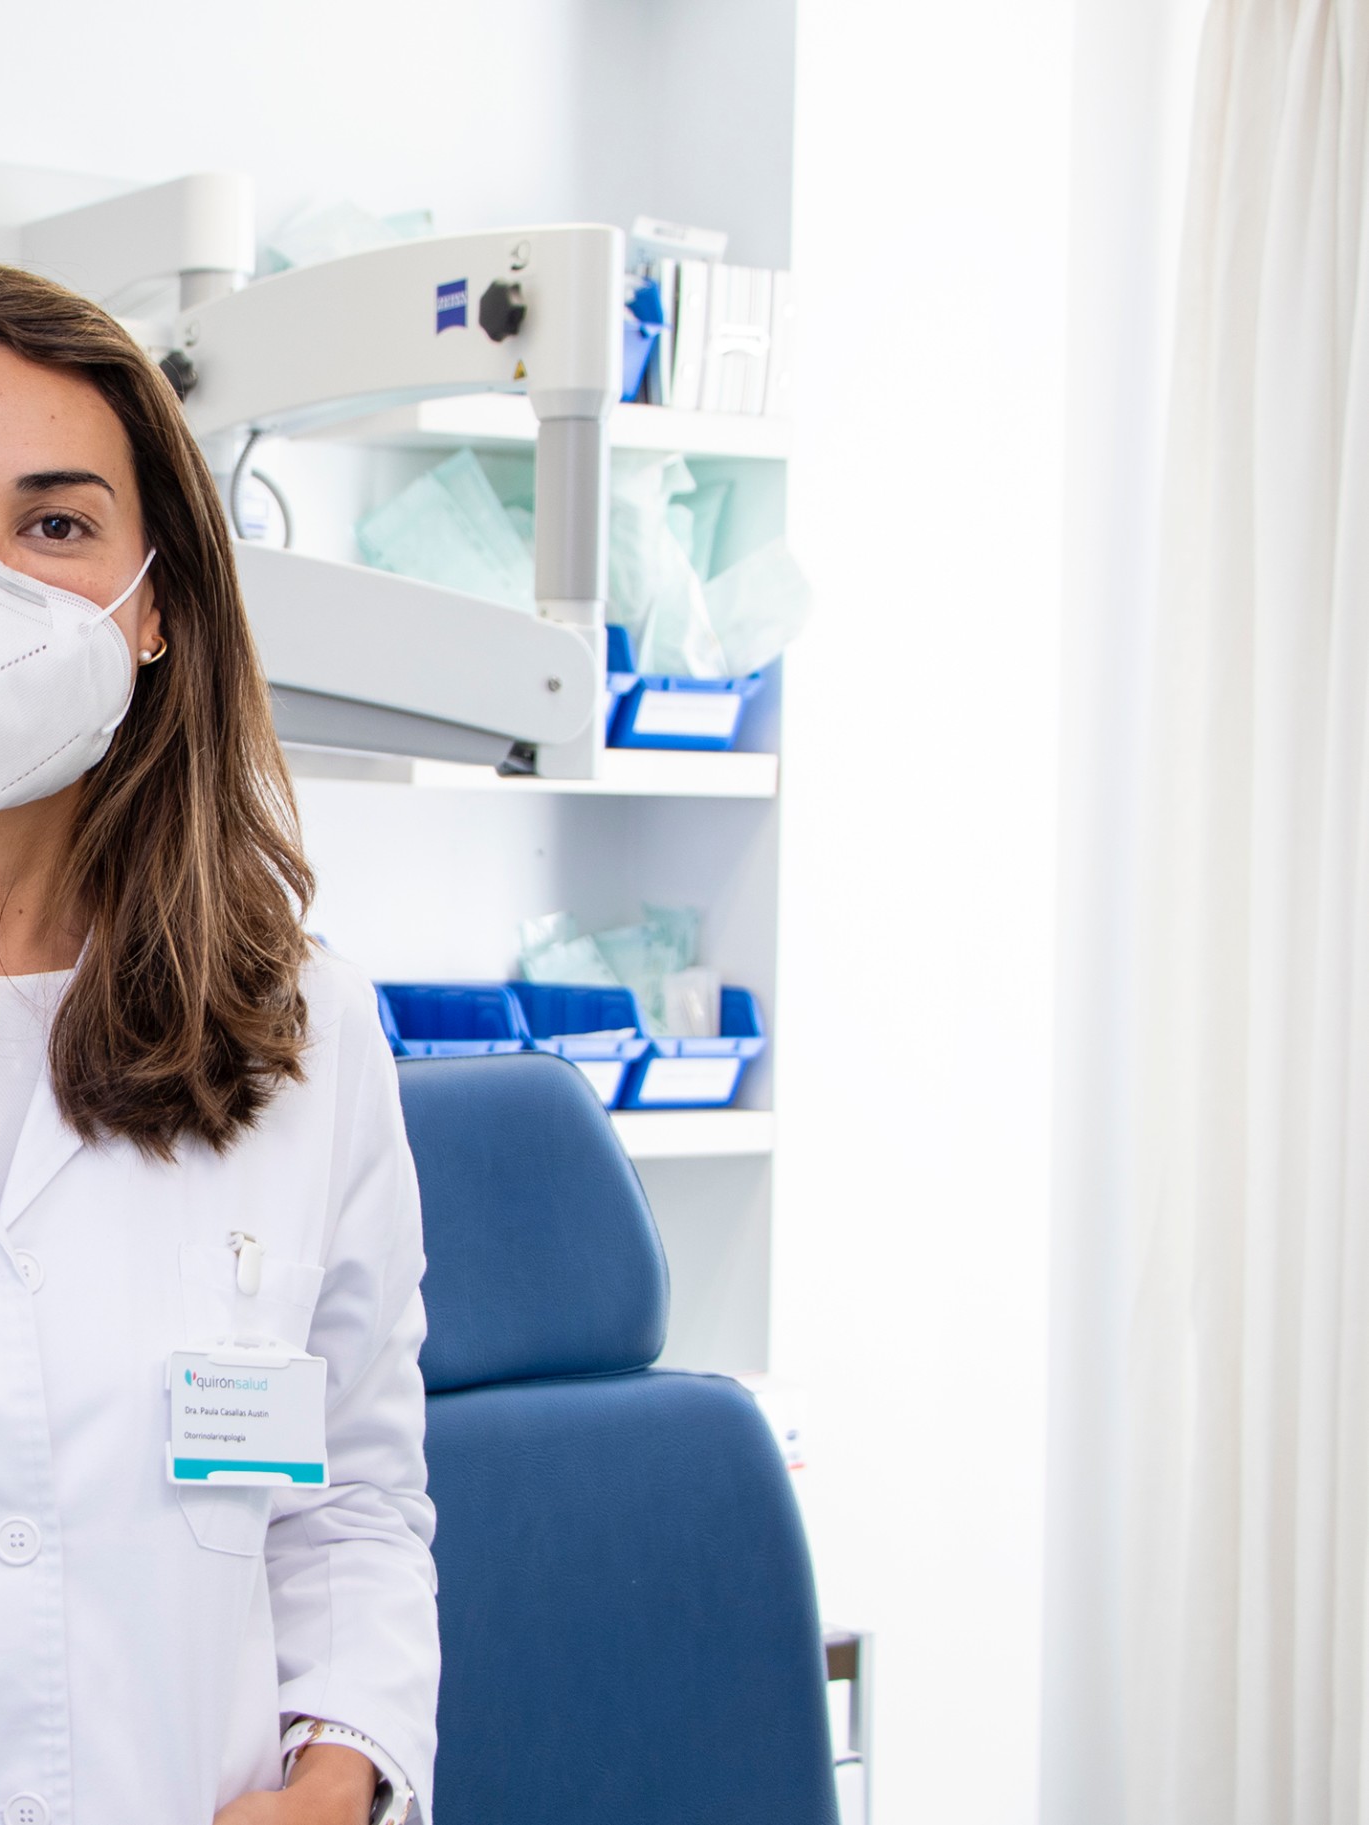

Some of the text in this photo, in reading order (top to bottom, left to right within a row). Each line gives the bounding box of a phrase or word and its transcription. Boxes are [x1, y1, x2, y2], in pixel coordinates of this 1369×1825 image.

[437, 291, 467, 310] ZEISS
[184, 1406, 198, 1415] Dra.
[200, 1407, 219, 1416] Paula
[248, 1410, 269, 1418] Austin
